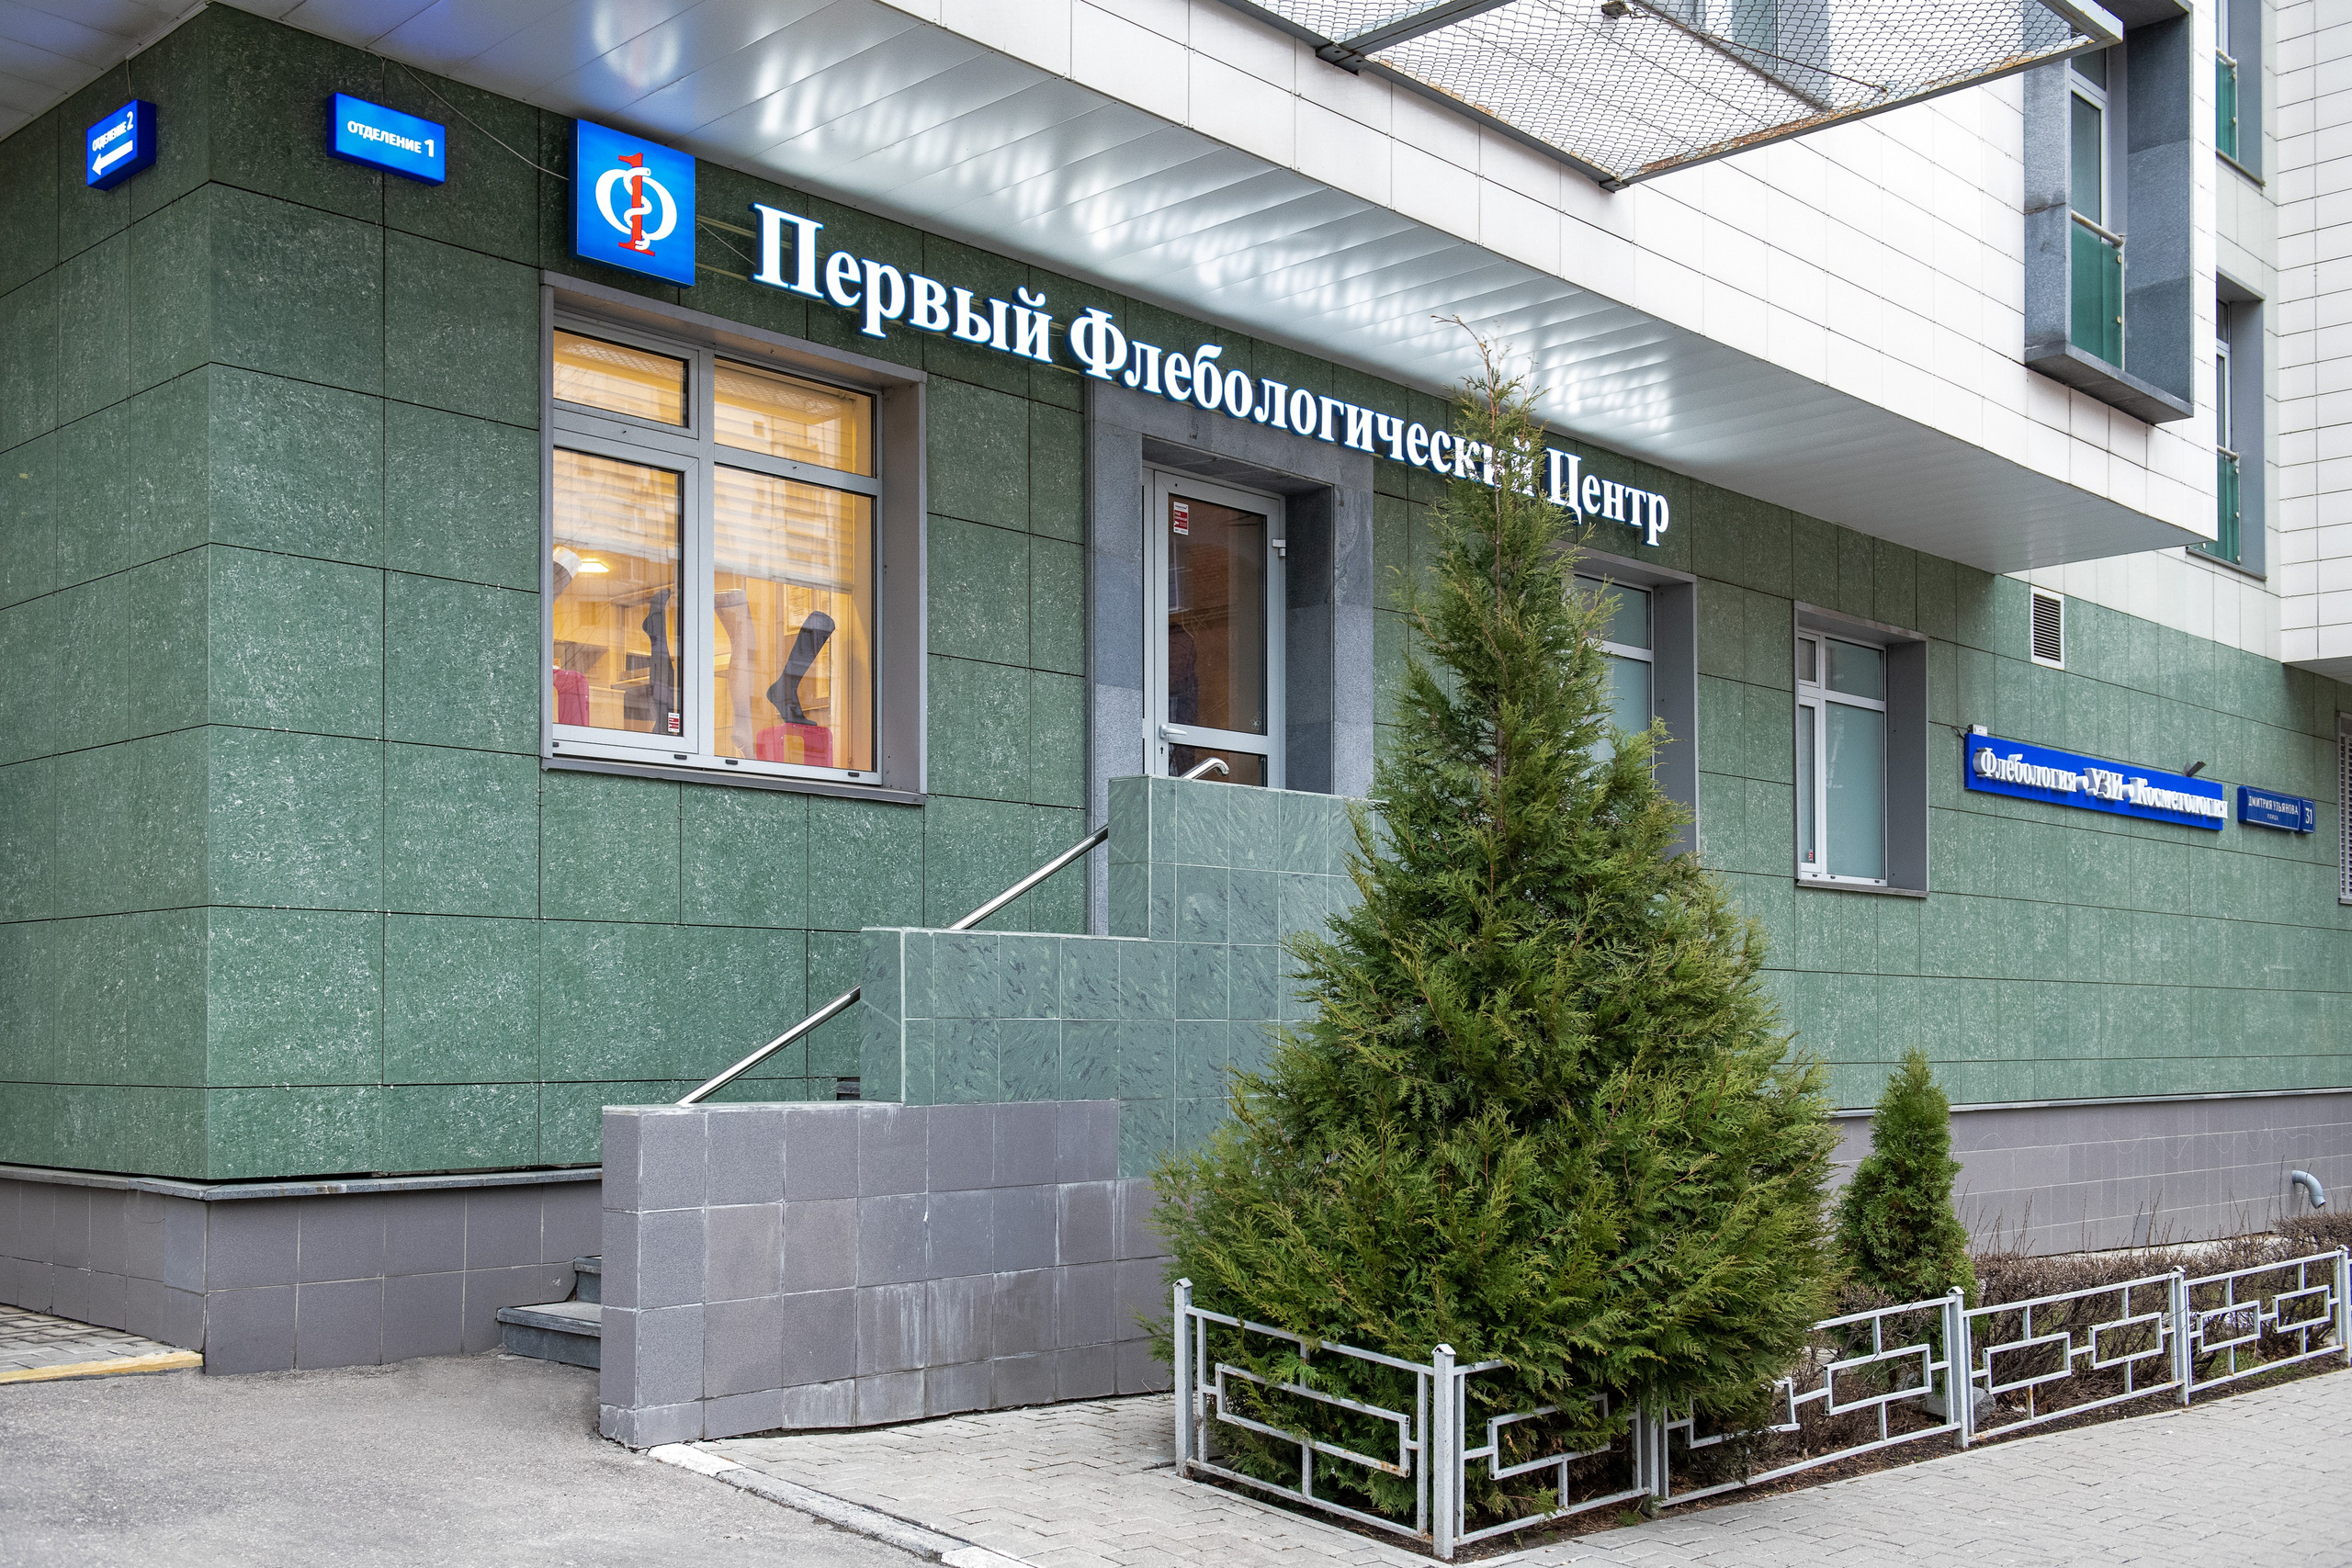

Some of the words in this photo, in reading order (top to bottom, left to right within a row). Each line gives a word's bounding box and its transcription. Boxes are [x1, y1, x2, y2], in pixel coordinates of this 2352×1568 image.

[127, 111, 134, 131] 2
[347, 120, 422, 154] ОТДЕЛЕНИЕ
[424, 139, 435, 158] 1
[752, 201, 1054, 364] Первый
[1546, 446, 1669, 547] Центр
[1975, 747, 2077, 792] Флебология
[2083, 767, 2124, 801] УЗИ
[2129, 776, 2228, 819] Косметология
[2304, 807, 2313, 825] 31
